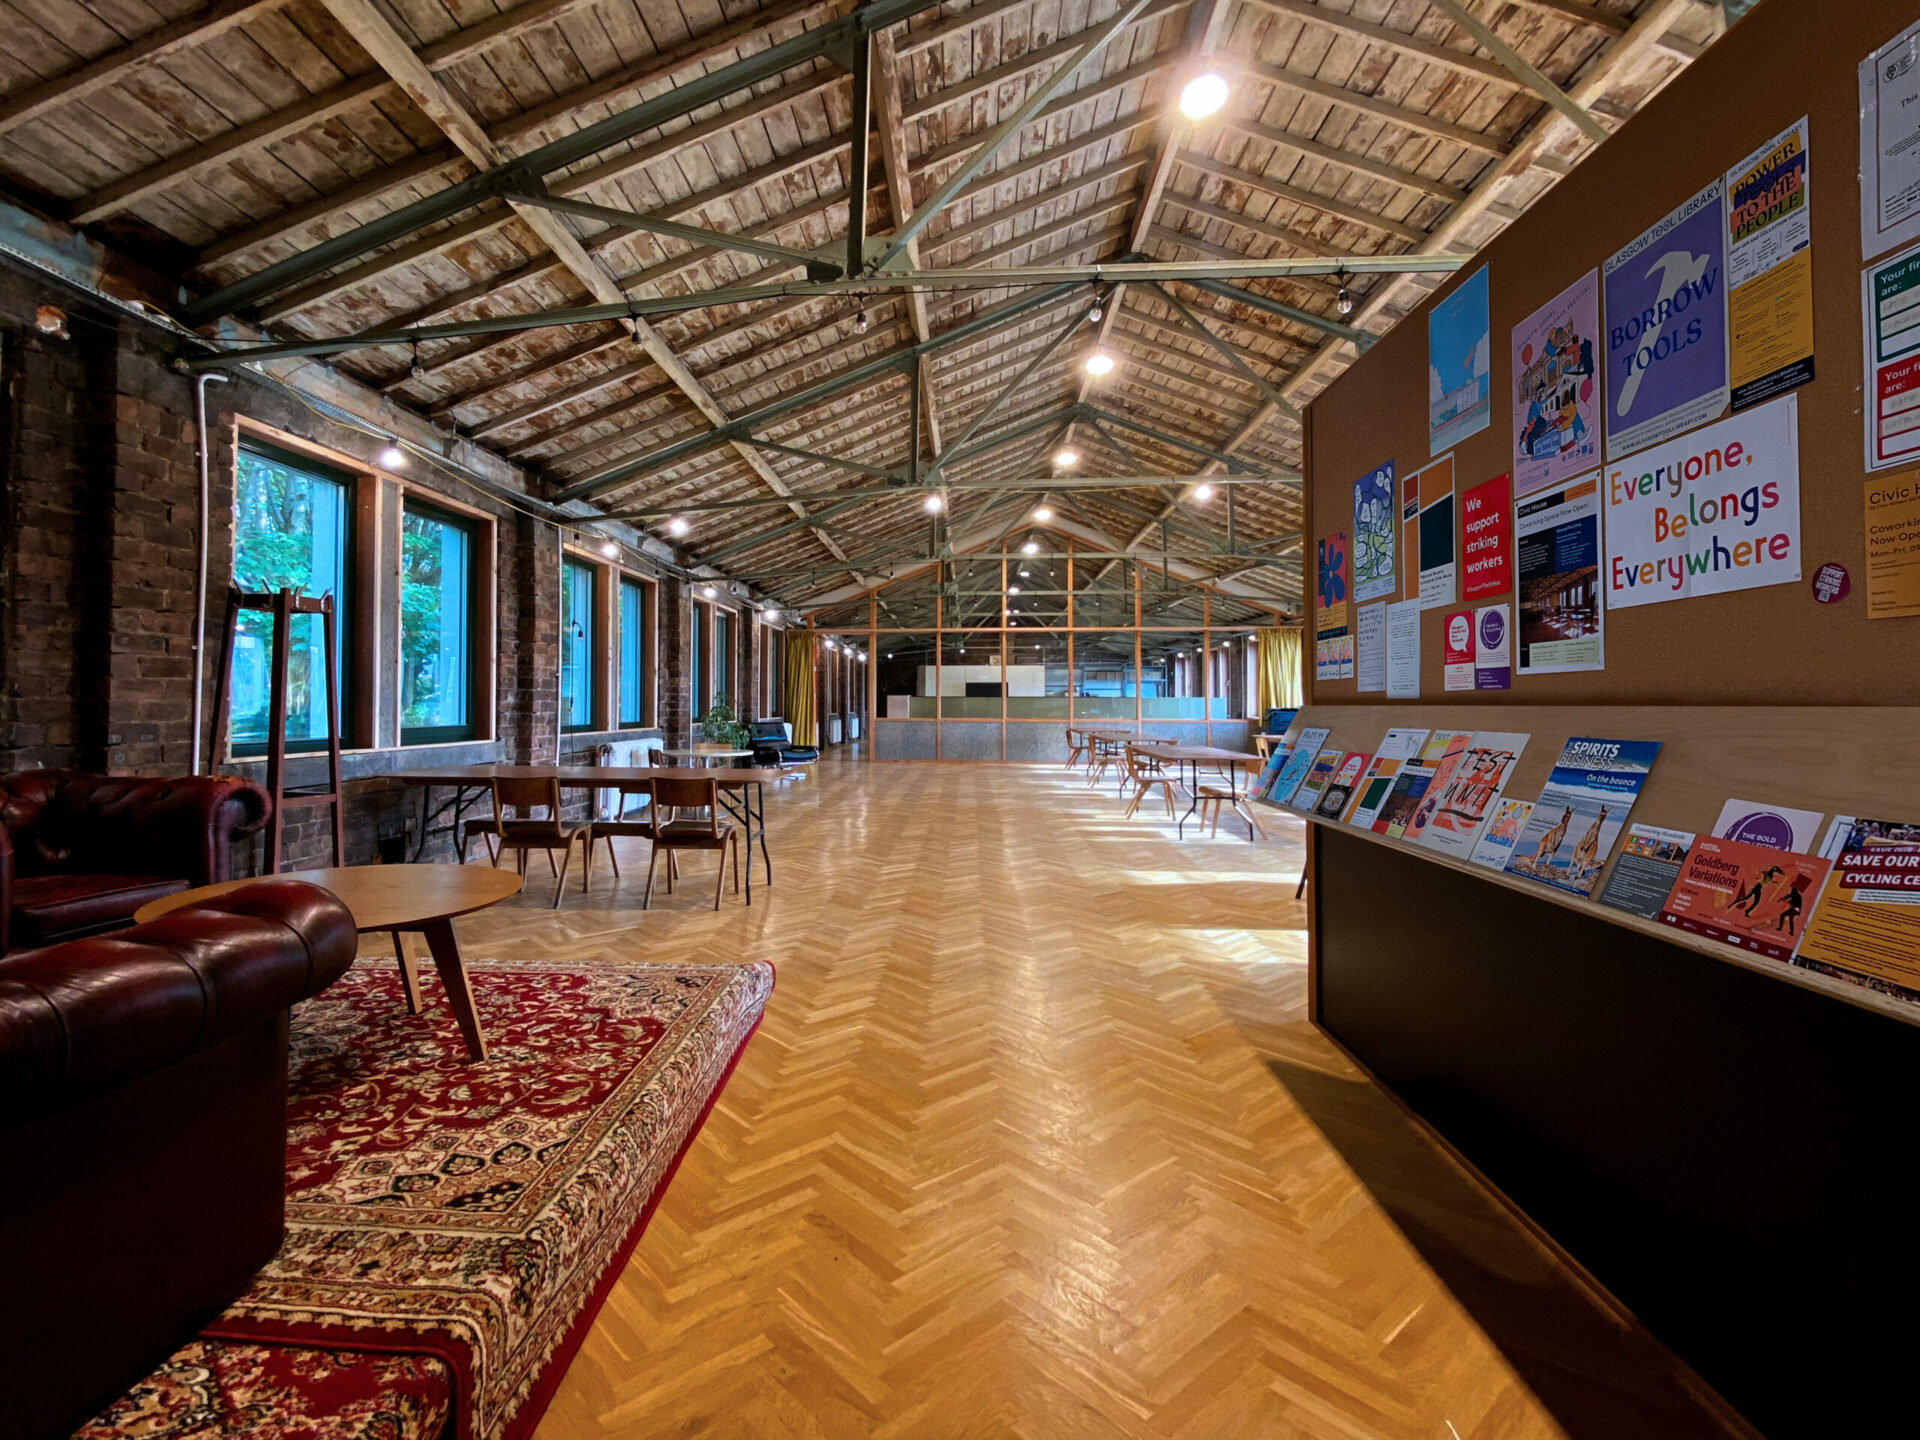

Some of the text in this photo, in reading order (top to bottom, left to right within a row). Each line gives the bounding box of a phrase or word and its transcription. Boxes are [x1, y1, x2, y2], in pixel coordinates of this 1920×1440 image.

[1735, 142, 1796, 197] POWER
[1737, 175, 1797, 225] TO THE
[1736, 191, 1800, 240] PEOPLE
[1604, 180, 1724, 273] GLASGOW TOOL LIBRARY
[1880, 266, 1905, 285] Your
[1881, 280, 1902, 297] are:
[1610, 266, 1718, 351] BORROW
[1622, 317, 1702, 377] TOOLS
[1884, 366, 1911, 382] Your
[1884, 380, 1907, 394] are:
[1610, 441, 1753, 506] Everyone,
[1465, 497, 1482, 512] We
[1869, 487, 1910, 505] Civic
[1654, 481, 1780, 543] Belongs
[1466, 512, 1500, 534] support
[1466, 535, 1498, 554] striking
[1870, 535, 1896, 547] Now
[1466, 555, 1503, 574] workers
[1611, 533, 1791, 591] Everywhere
[1570, 741, 1621, 758] SPIRITS
[1461, 747, 1517, 775] TEST
[1559, 753, 1615, 770] BUSINESS
[1586, 773, 1596, 782] On
[1597, 774, 1609, 784] the
[1609, 776, 1637, 787] bounce
[1742, 832, 1777, 844] THE BOLD
[1694, 853, 1740, 876] Goldberg
[1841, 854, 1920, 868] SAVE OUR
[1688, 866, 1738, 889] Variations
[1845, 873, 1902, 885] CYCLING
